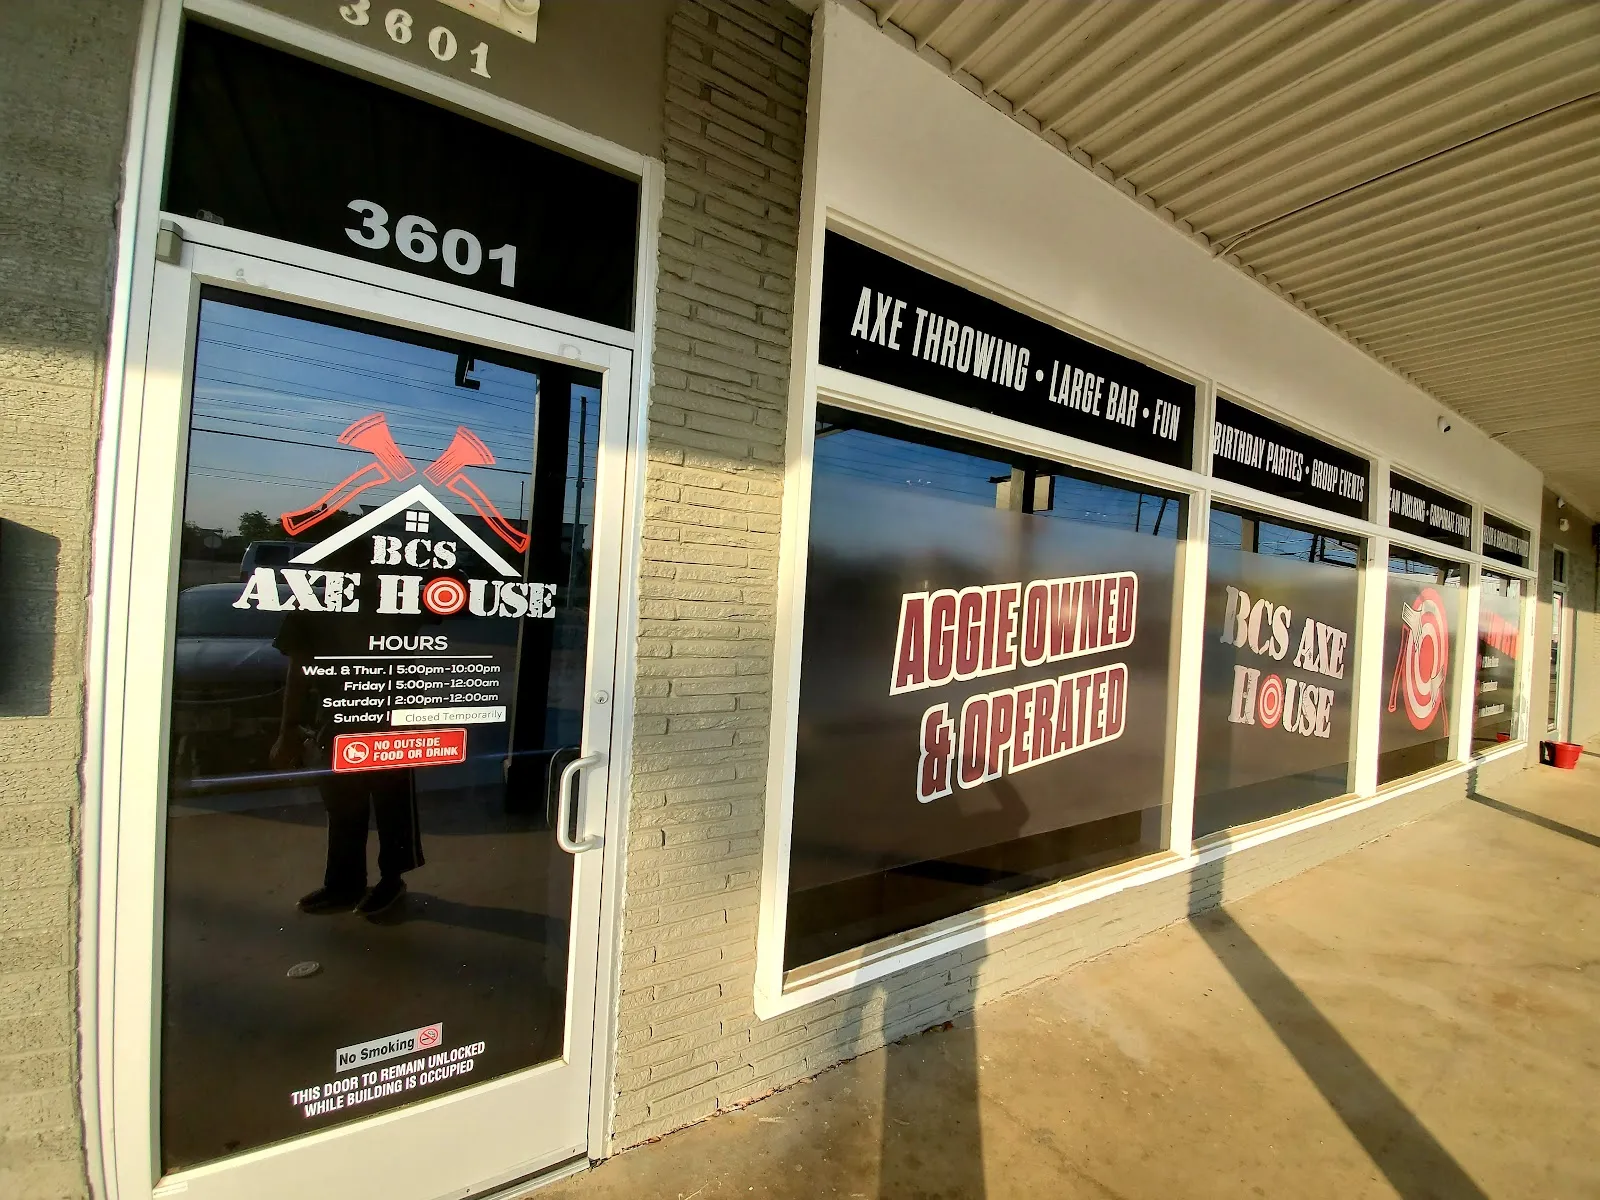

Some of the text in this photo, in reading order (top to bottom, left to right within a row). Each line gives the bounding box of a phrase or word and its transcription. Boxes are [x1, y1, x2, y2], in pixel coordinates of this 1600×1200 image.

[339, 0, 492, 79] 3601
[344, 199, 517, 288] 3601
[850, 285, 1182, 442] AXE THROWING LARGE BAR FUN
[1213, 420, 1365, 503] BIRTHDAY PARTIES GROUP EVENTS
[370, 534, 457, 570] BCS
[232, 566, 557, 619] AXE HOUSE
[368, 635, 449, 651] HOURS
[889, 571, 1138, 696] AGGIE OWNED
[1219, 585, 1348, 680] BCS AXE
[301, 663, 501, 677] Wed. & Thur. 5:00pm-10:00pm
[343, 678, 500, 693] Friday 5:00pm-12:00am
[322, 692, 499, 709] Saturday 2:00pm-12:00am
[333, 709, 503, 724] Sunday Closed Temporarily
[1228, 664, 1335, 739] HOUSE
[373, 737, 441, 750] NO OUTSIDE
[373, 746, 458, 762] FOOD OR DRINK
[917, 662, 1129, 804] & OPERATED
[291, 1041, 486, 1106] THIS DOOR TO REMAIN UNLOCKED
[339, 1037, 415, 1067] No Smoking
[304, 1059, 474, 1118] WHILE BUILDING IS OCCUPIED
